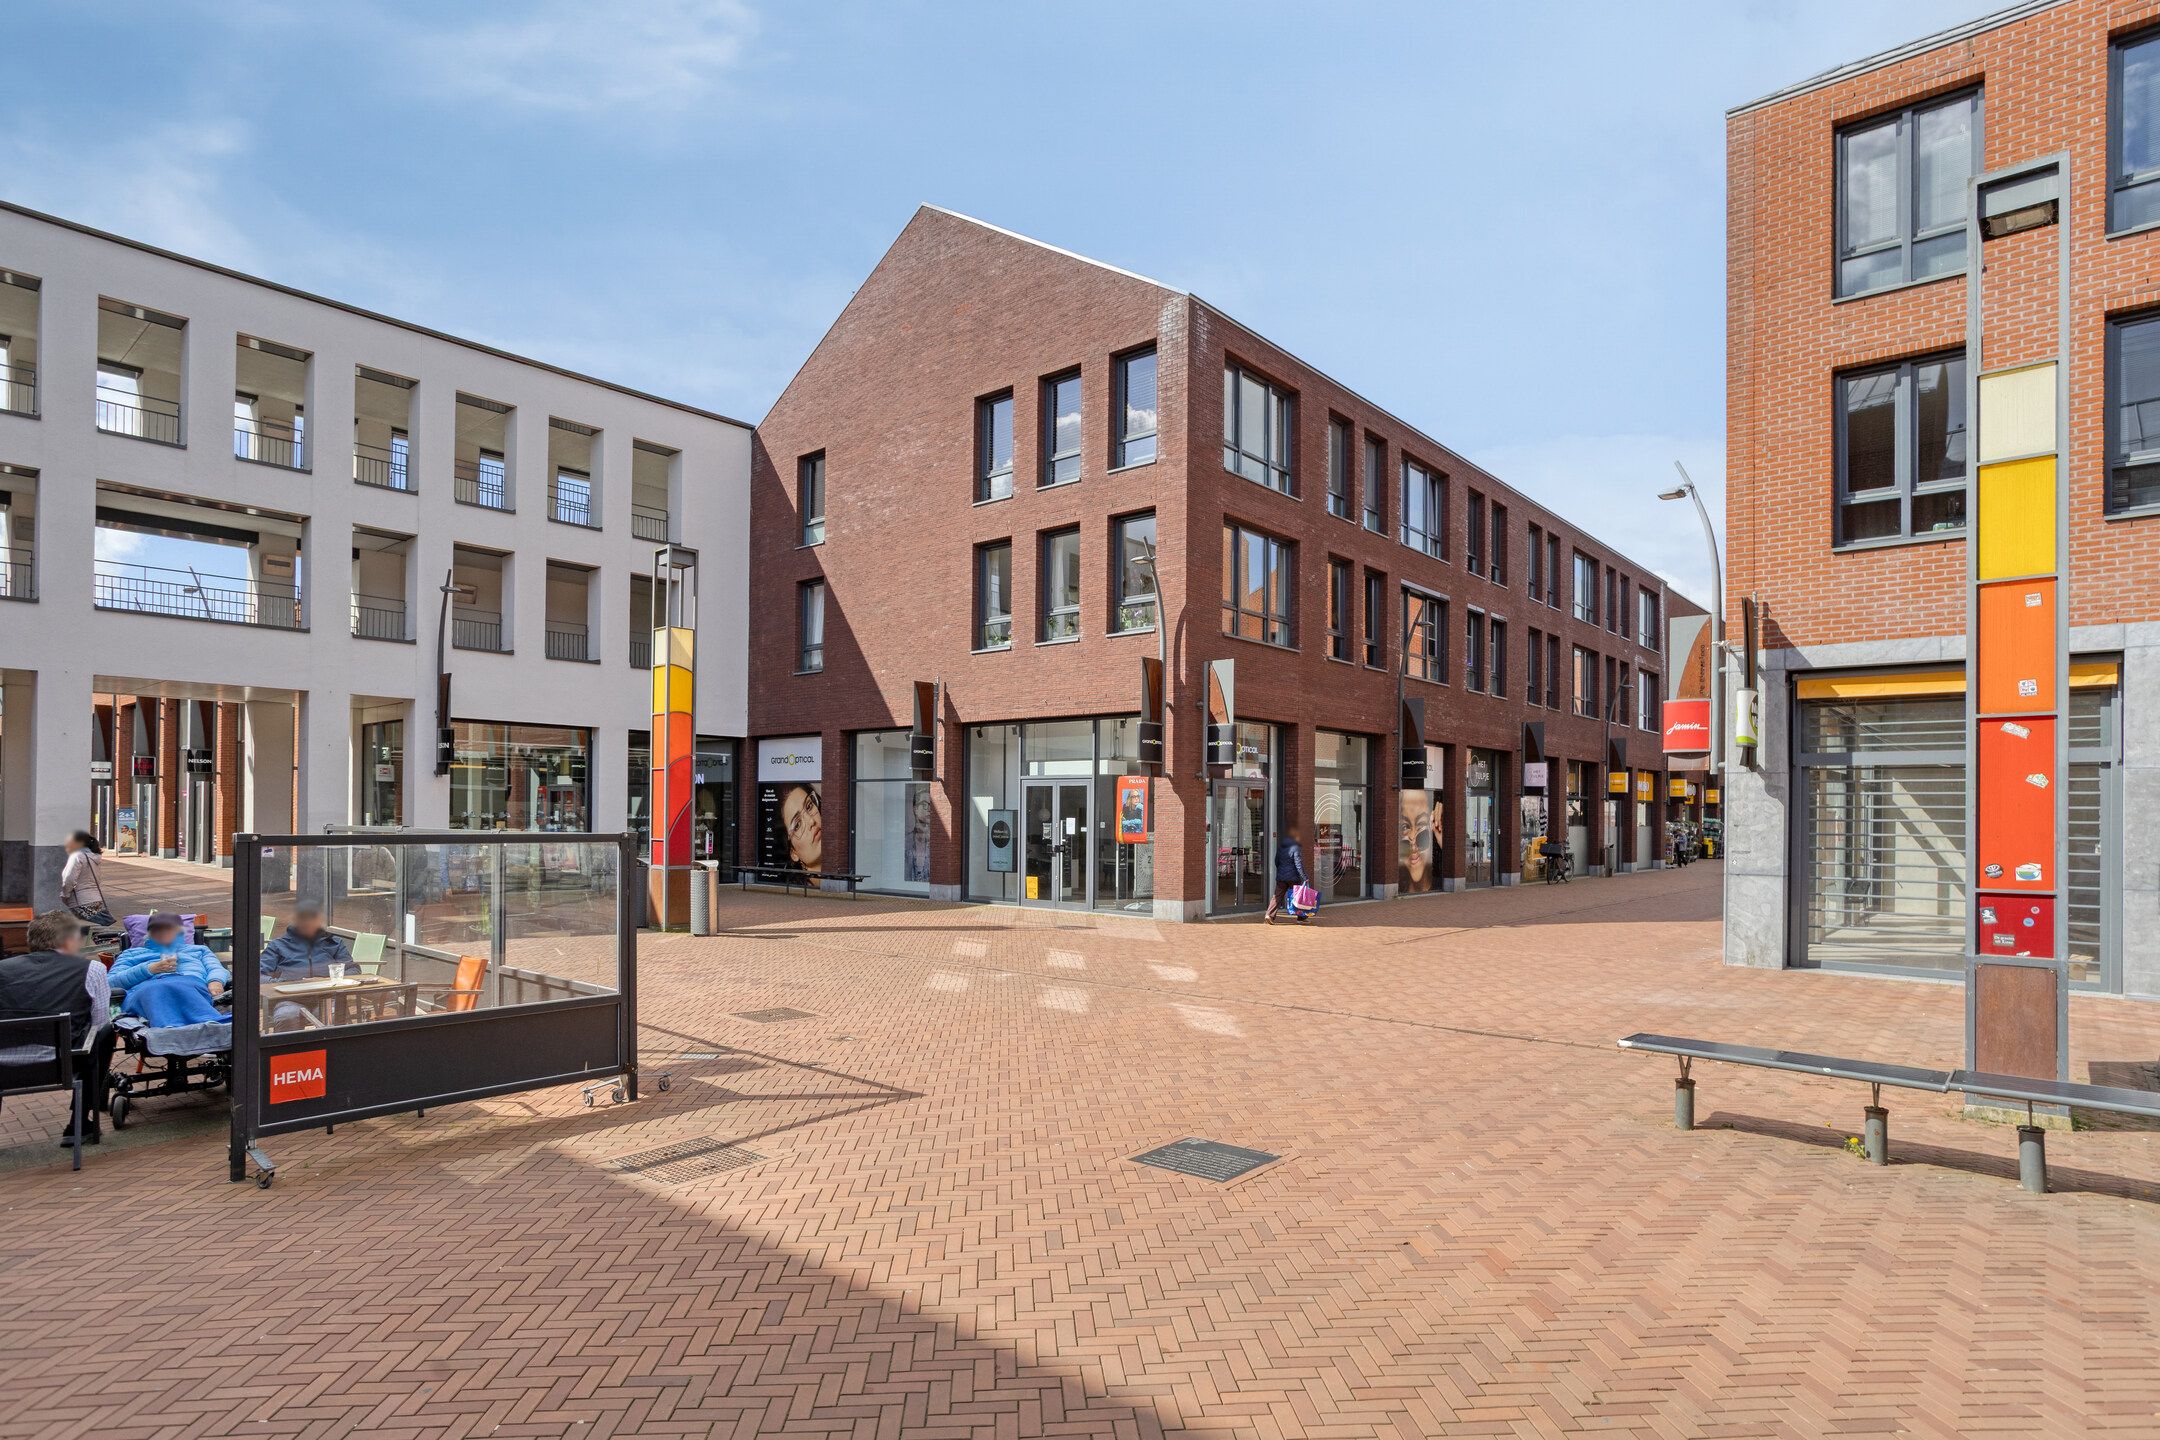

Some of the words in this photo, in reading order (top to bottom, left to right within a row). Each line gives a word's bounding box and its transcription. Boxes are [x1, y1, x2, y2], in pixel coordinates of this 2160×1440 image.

[1666, 721, 1708, 736] jamin
[1477, 760, 1486, 768] HET
[118, 811, 136, 819] 2+1
[273, 1067, 324, 1086] HEMA
